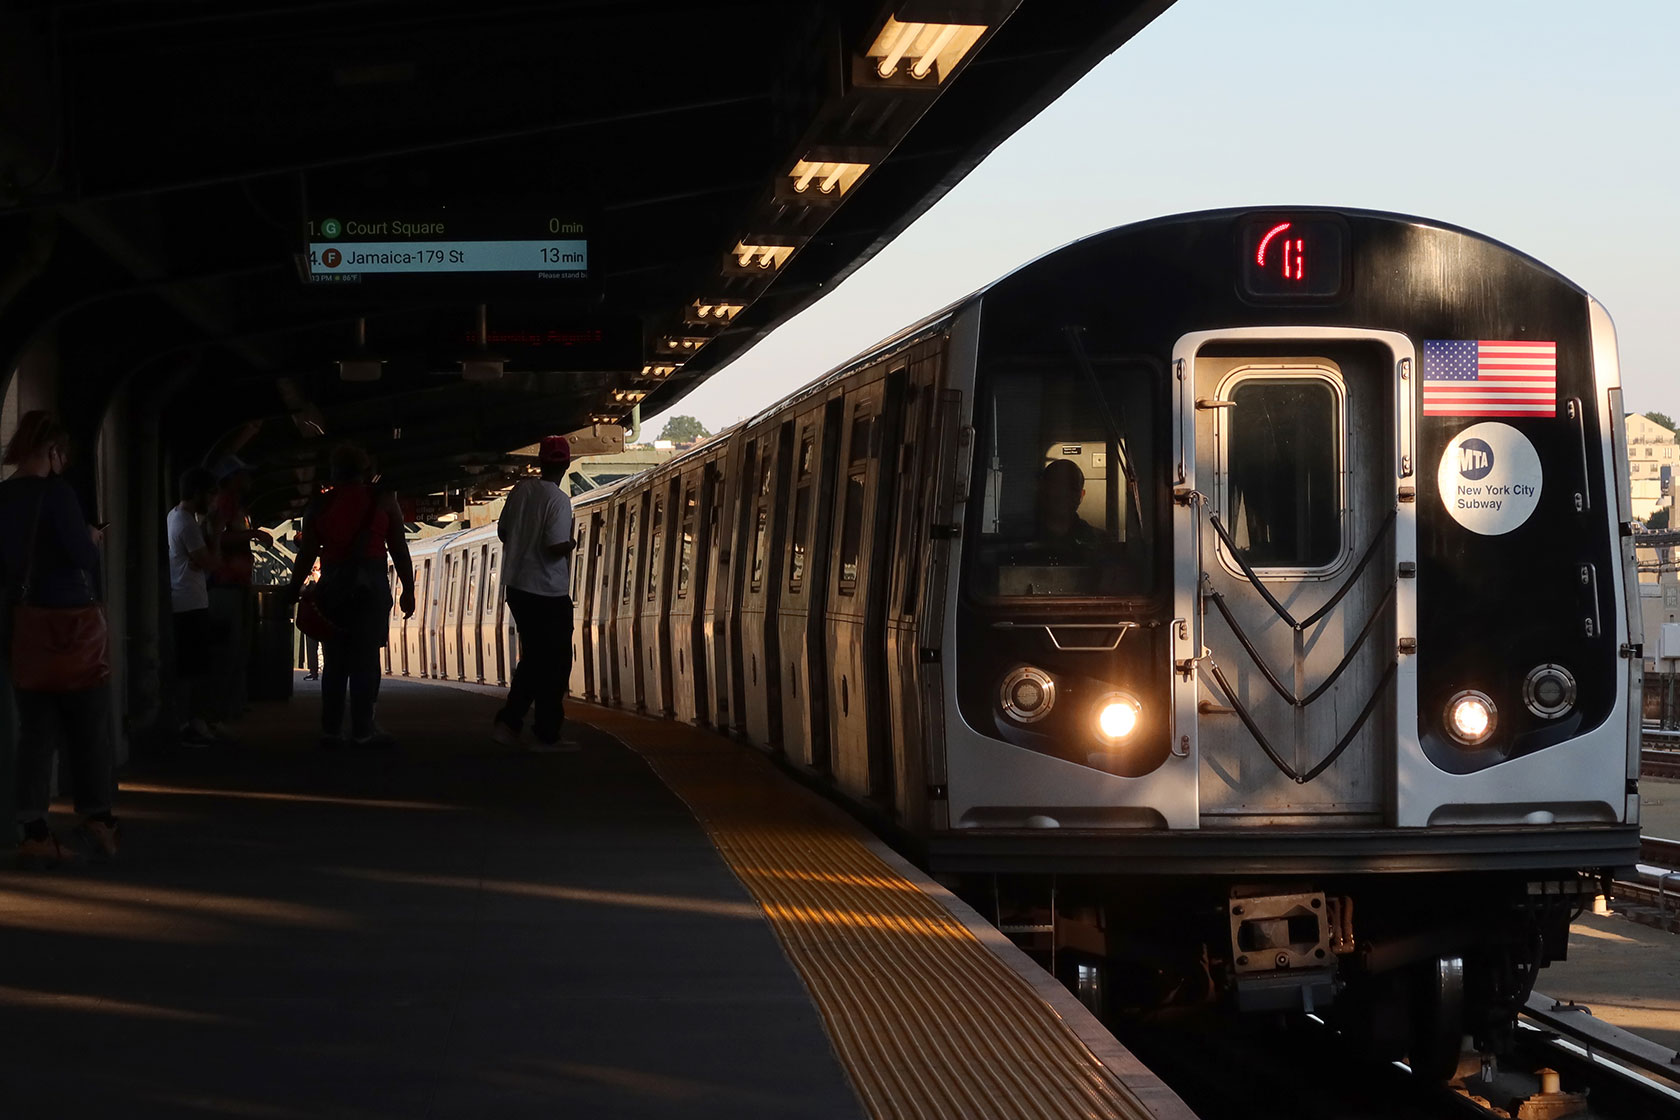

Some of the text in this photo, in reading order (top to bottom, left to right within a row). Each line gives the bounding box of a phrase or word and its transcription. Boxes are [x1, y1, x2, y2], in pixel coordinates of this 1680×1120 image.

[346, 220, 388, 236] Court
[392, 220, 445, 238] Square
[549, 217, 560, 234] 0
[562, 222, 584, 233] min
[347, 250, 445, 265] Jamaica-179
[449, 248, 465, 264] St
[540, 247, 560, 263] 13
[562, 251, 584, 263] min
[538, 271, 561, 279] Please
[561, 271, 580, 279] stand
[1458, 447, 1489, 473] MTA
[1457, 484, 1535, 498] New York City
[1457, 498, 1502, 511] Subway
